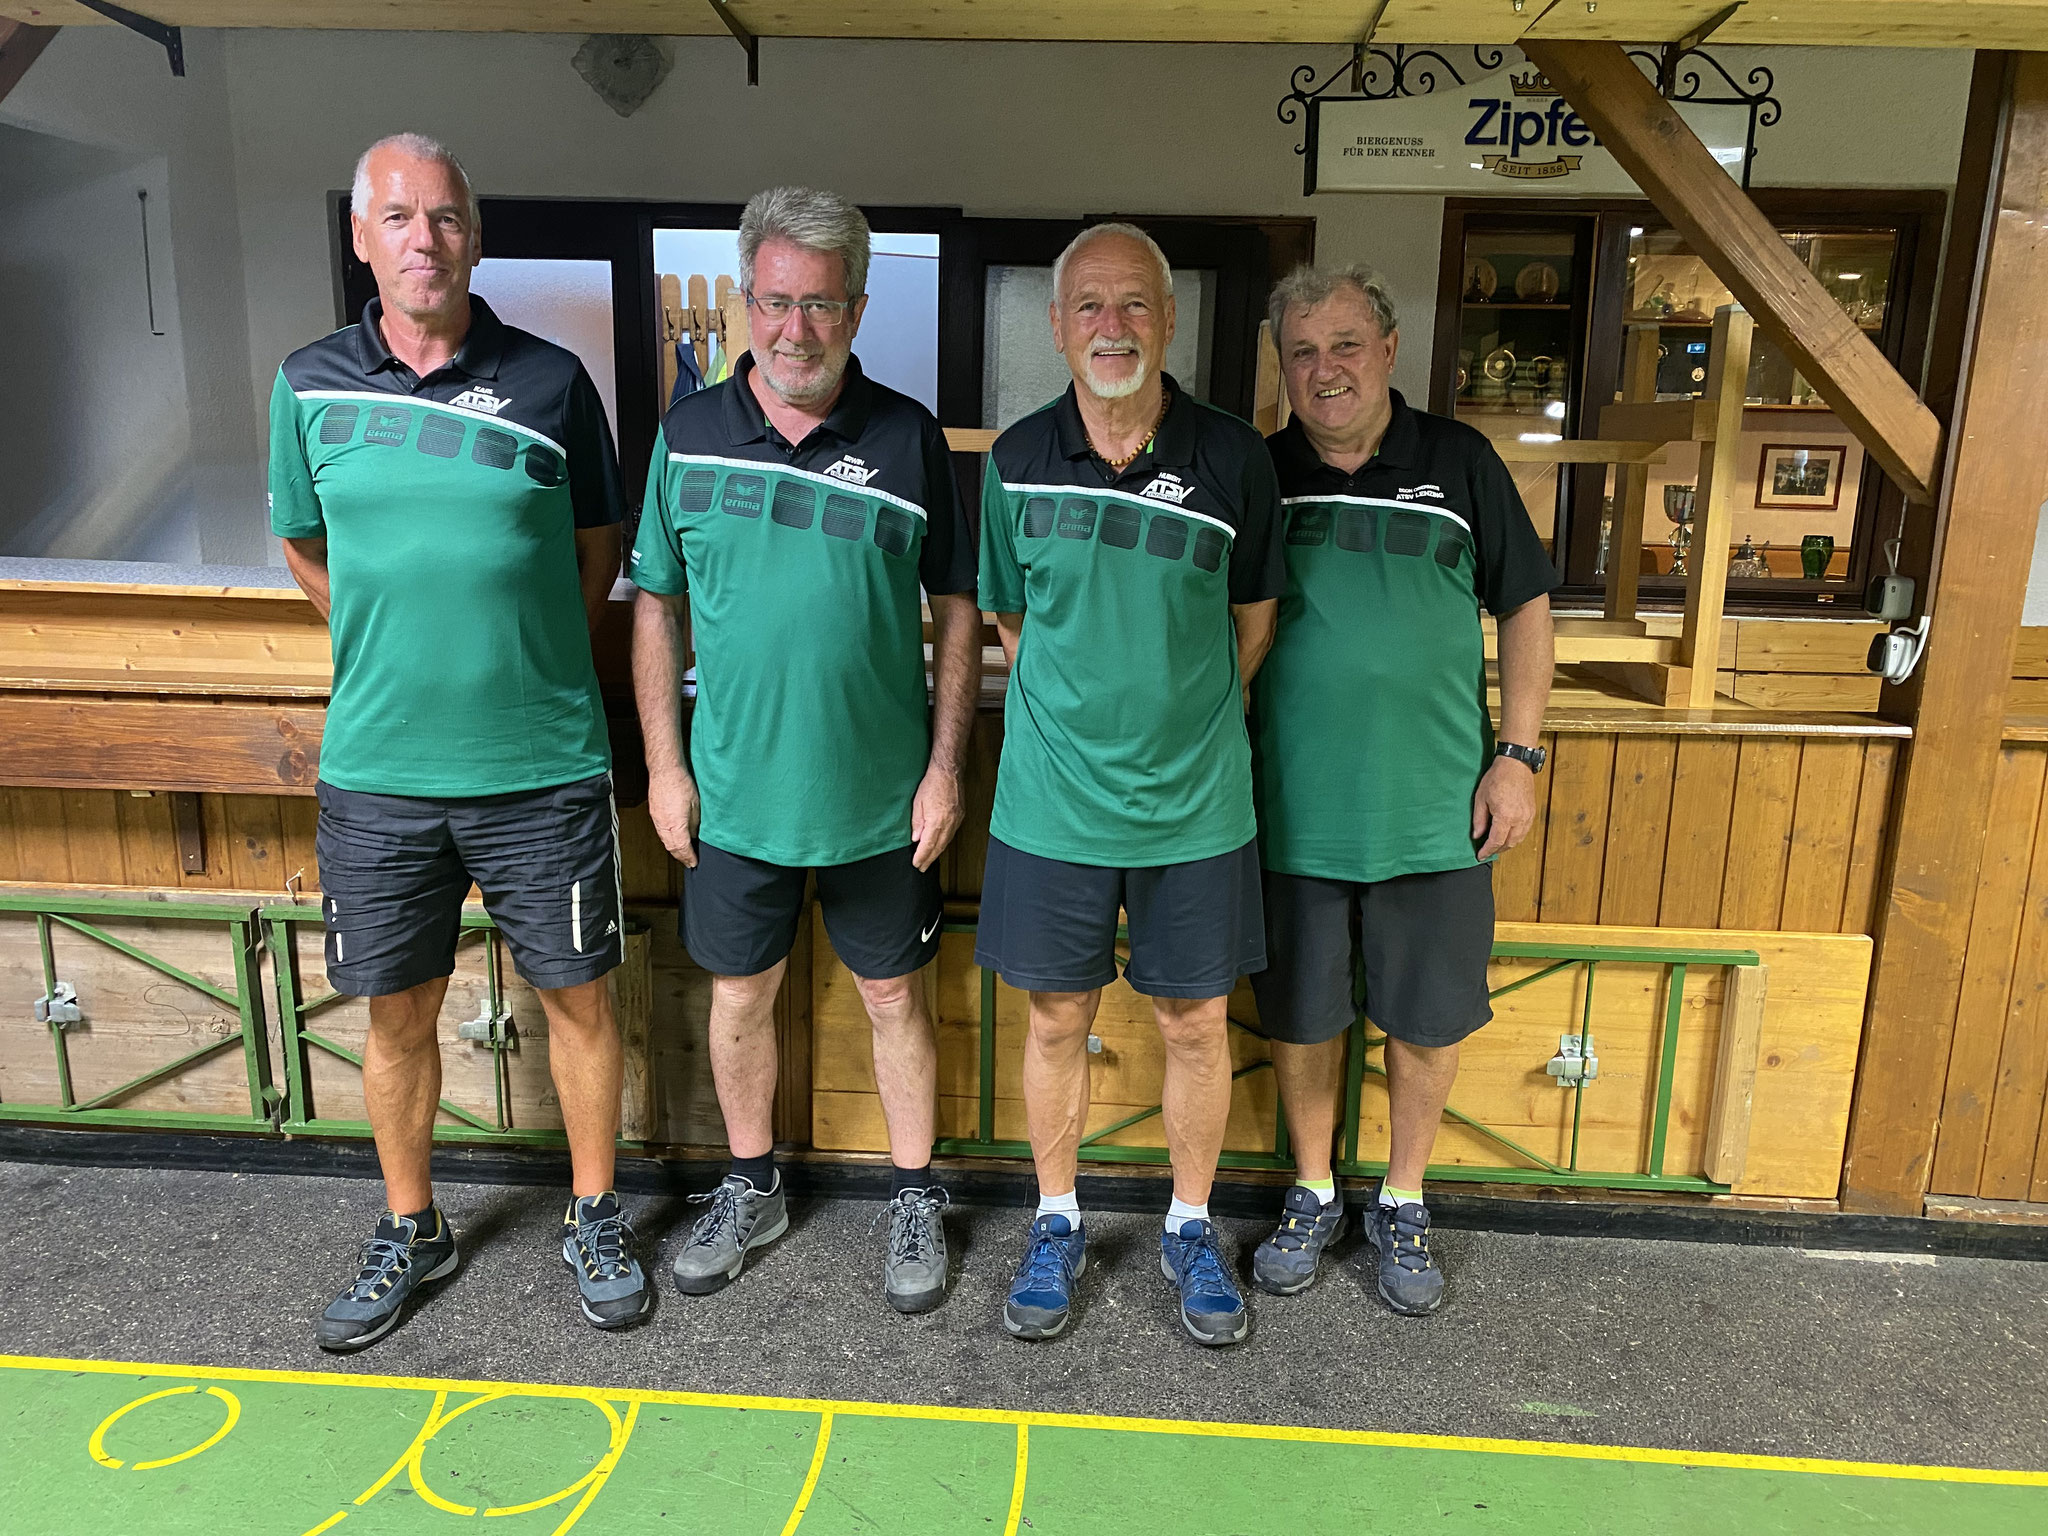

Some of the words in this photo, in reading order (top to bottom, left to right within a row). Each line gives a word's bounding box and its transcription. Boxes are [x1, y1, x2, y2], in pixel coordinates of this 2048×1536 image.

[1464, 98, 1603, 158] Zipfe
[1356, 136, 1424, 146] BIERGENUSS
[1343, 146, 1364, 157] FÜR
[1366, 147, 1389, 157] DEN
[1391, 148, 1435, 158] KENNER
[1500, 164, 1531, 175] SEIT
[1537, 164, 1564, 175] 1858
[448, 390, 513, 414] ATSV
[366, 429, 403, 440] erima
[843, 454, 866, 466] ERWIN
[822, 459, 880, 485] ATSV
[1157, 471, 1182, 484] HUBERT
[1138, 478, 1196, 503] ATSV
[1395, 493, 1414, 501] ATSV
[1415, 490, 1445, 498] LENZING
[725, 498, 760, 510] erima
[1059, 522, 1091, 532] erima
[1891, 585, 1896, 593] 8
